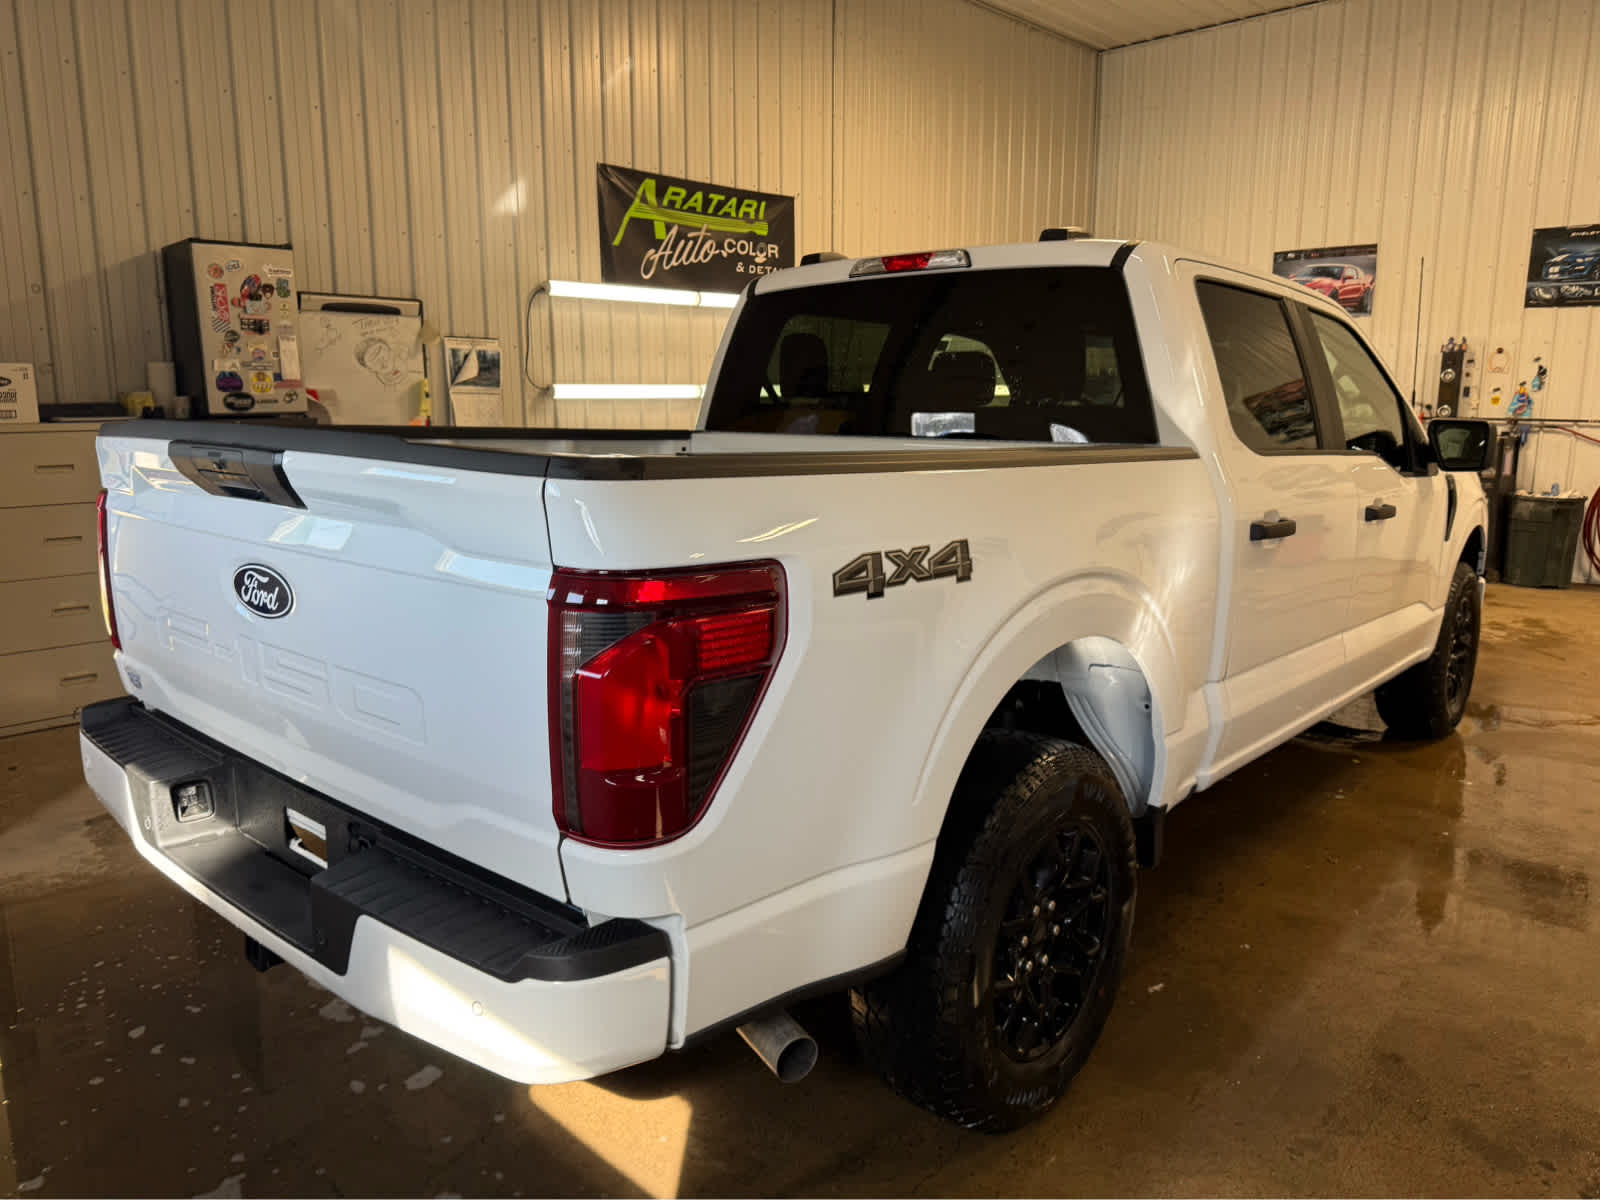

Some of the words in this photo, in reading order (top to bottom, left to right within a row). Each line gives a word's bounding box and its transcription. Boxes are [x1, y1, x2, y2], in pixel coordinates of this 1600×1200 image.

[612, 178, 768, 246] ARATARI
[640, 224, 720, 280] Auto
[723, 238, 780, 261] COLOR
[735, 261, 745, 273] &
[241, 570, 280, 610] Ford
